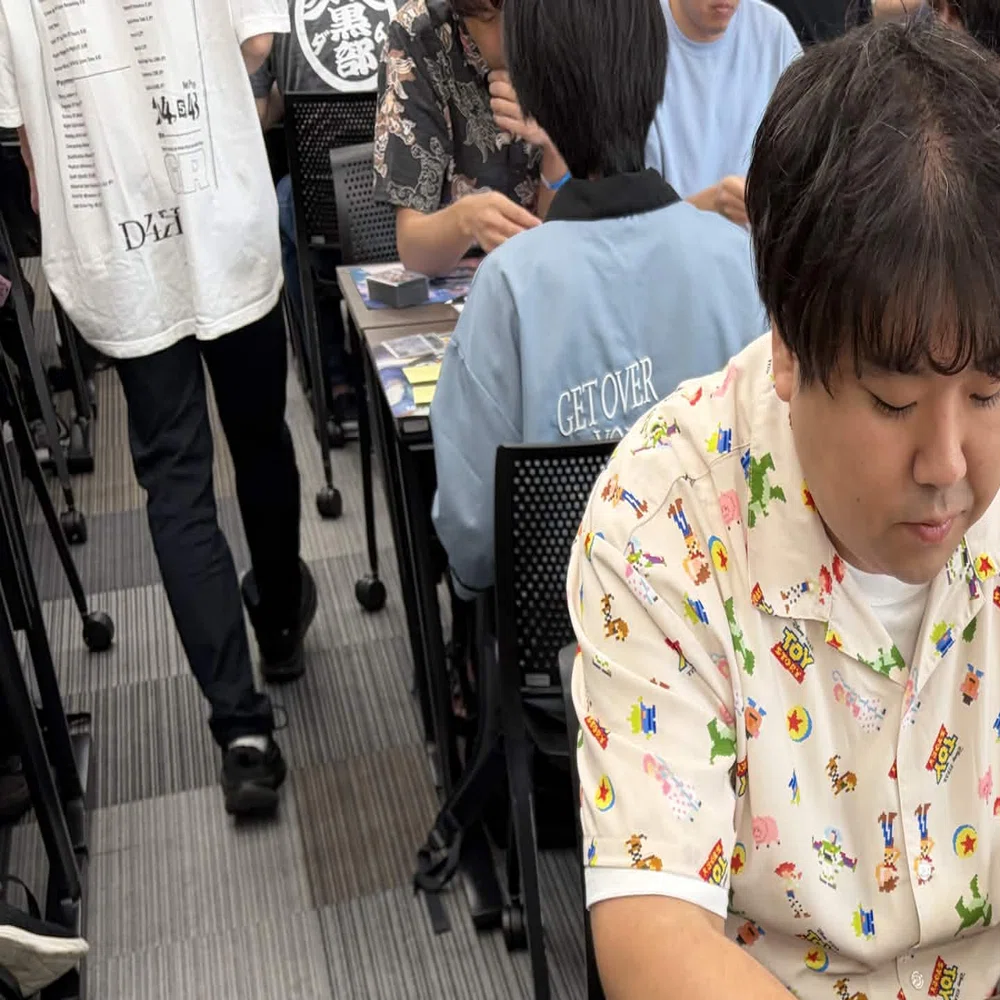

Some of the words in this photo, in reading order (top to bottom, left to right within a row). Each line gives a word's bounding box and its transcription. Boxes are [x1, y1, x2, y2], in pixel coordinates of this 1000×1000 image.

[557, 379, 598, 437] GET
[601, 356, 659, 419] OVER
[771, 642, 806, 684] STORY
[783, 626, 814, 669] TOY
[926, 724, 948, 771] STORY
[934, 734, 958, 784] TOY
[928, 956, 947, 997] STORY
